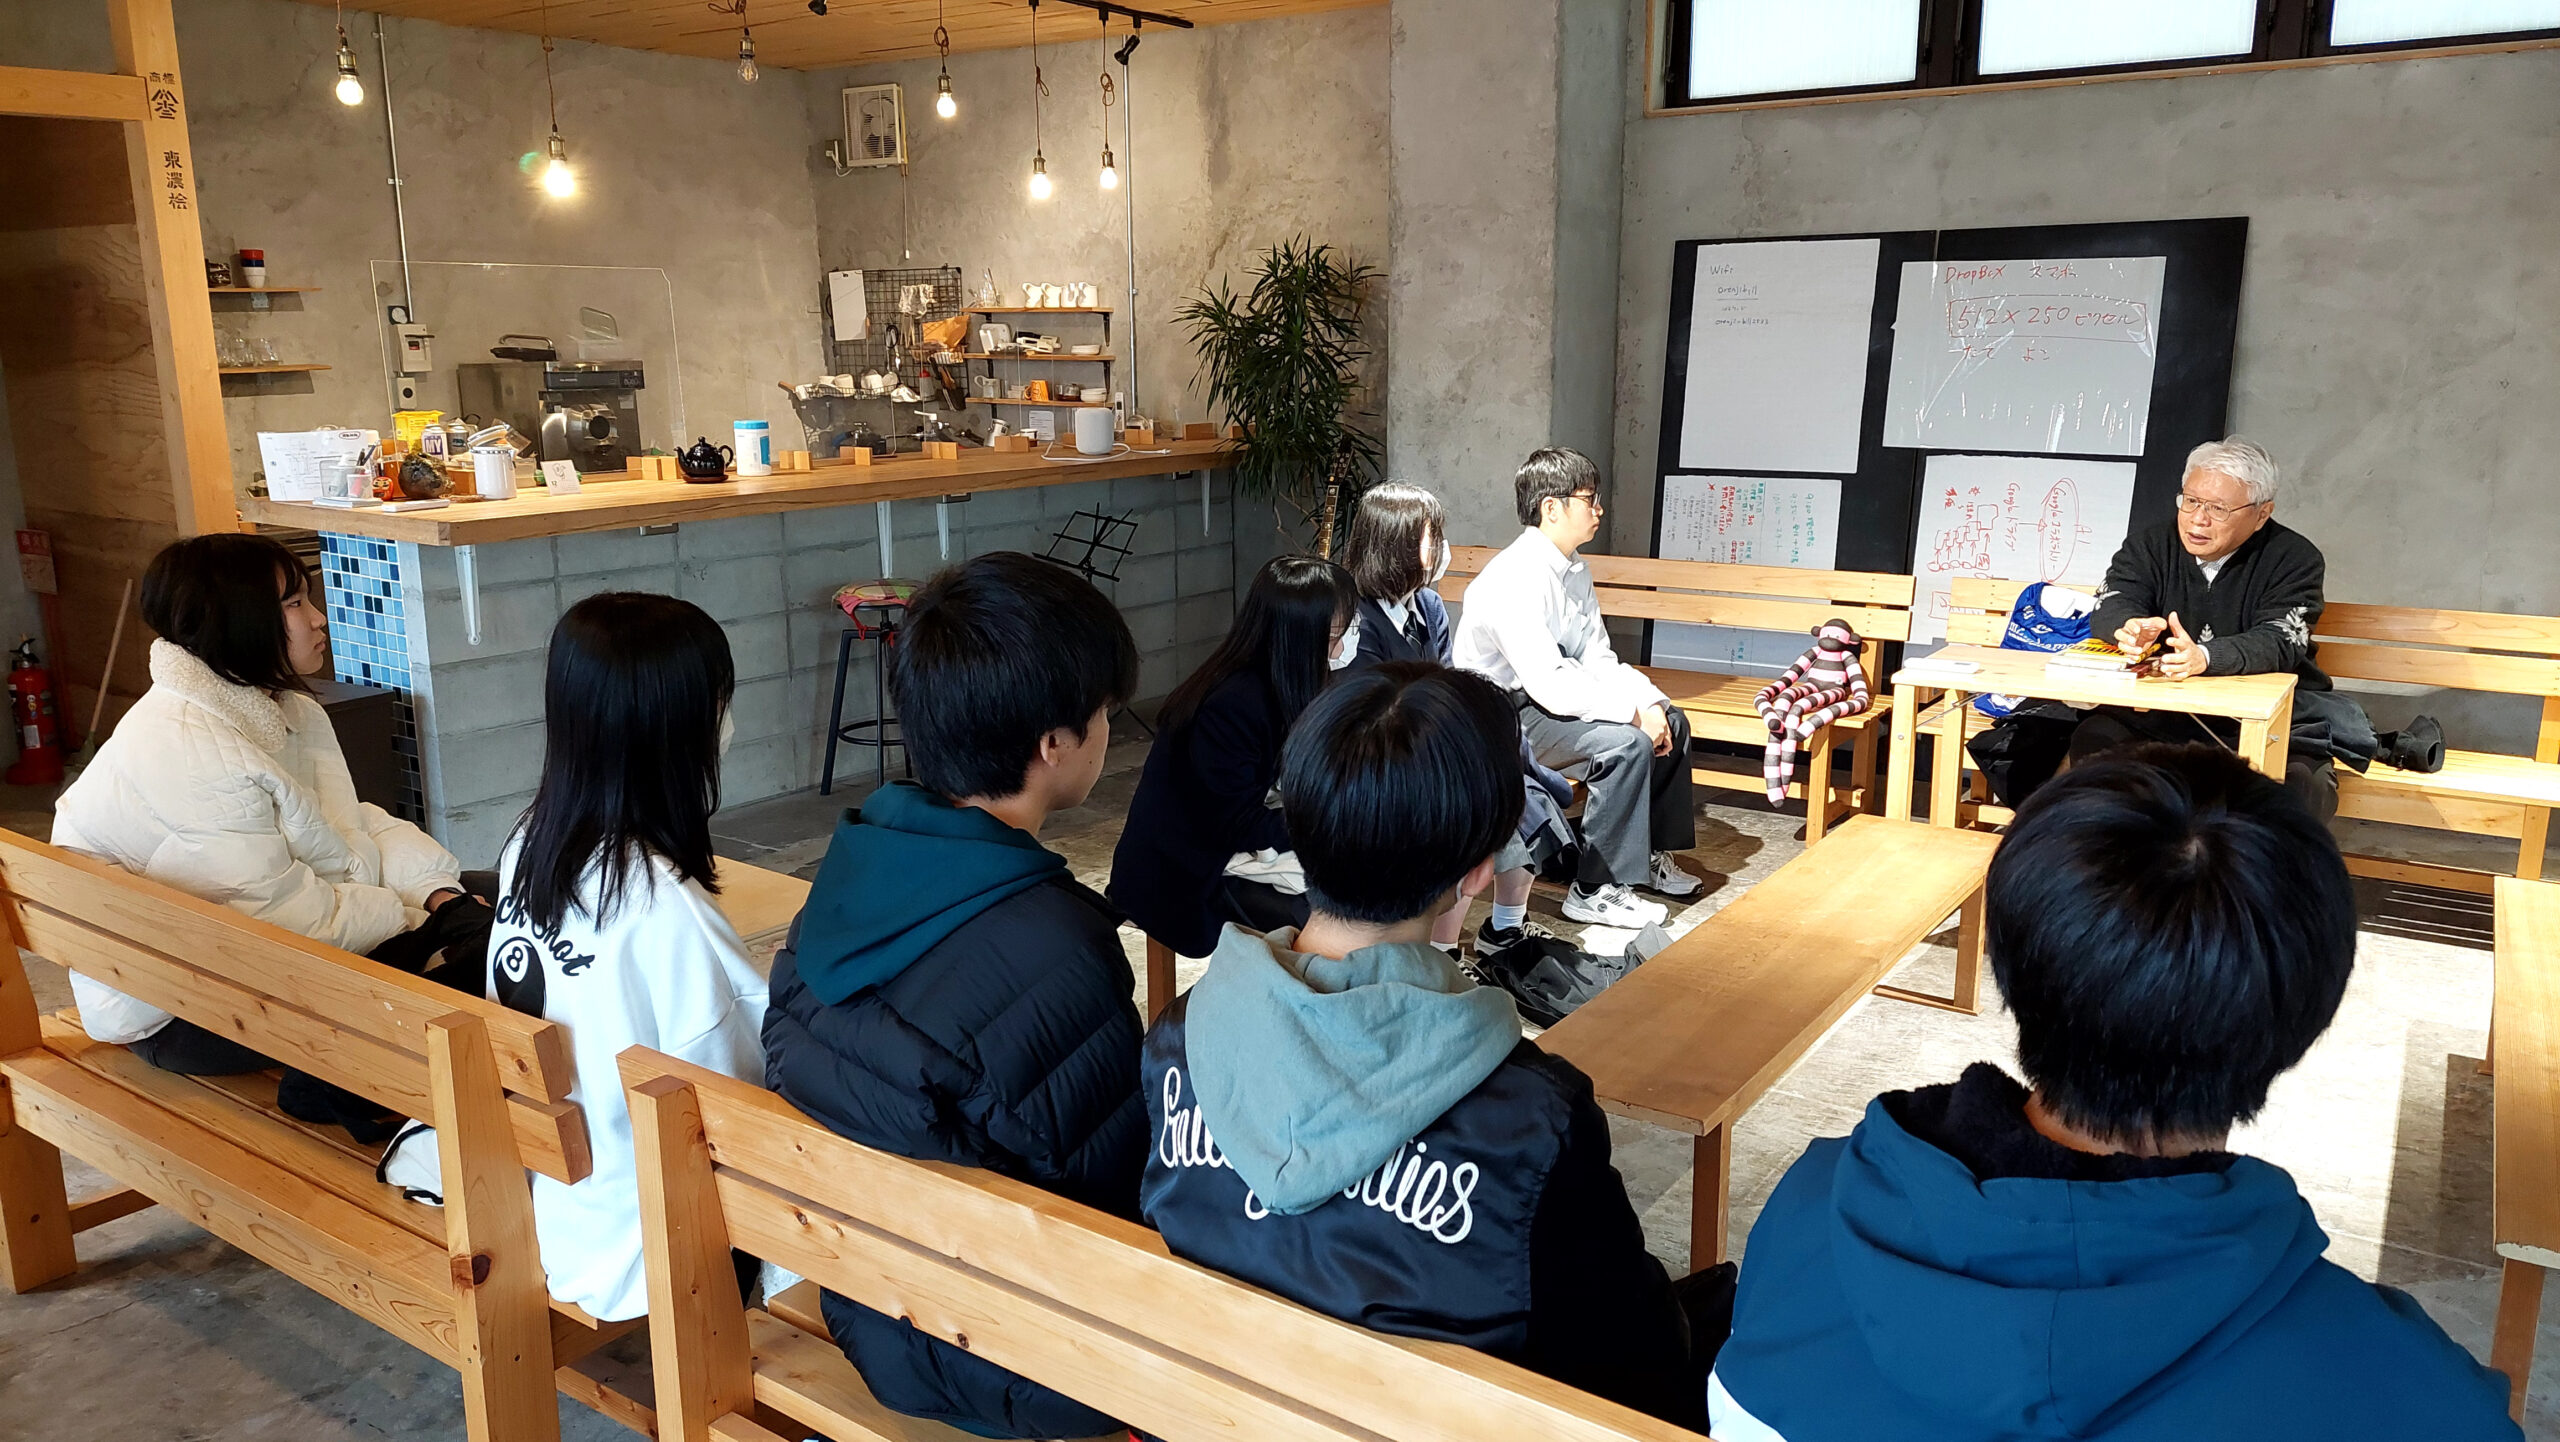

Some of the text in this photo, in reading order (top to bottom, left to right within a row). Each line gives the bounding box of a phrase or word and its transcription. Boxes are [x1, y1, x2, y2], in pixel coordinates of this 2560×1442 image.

[1957, 305, 1998, 330] 512
[2027, 306, 2071, 325] 250
[506, 945, 524, 973] 8
